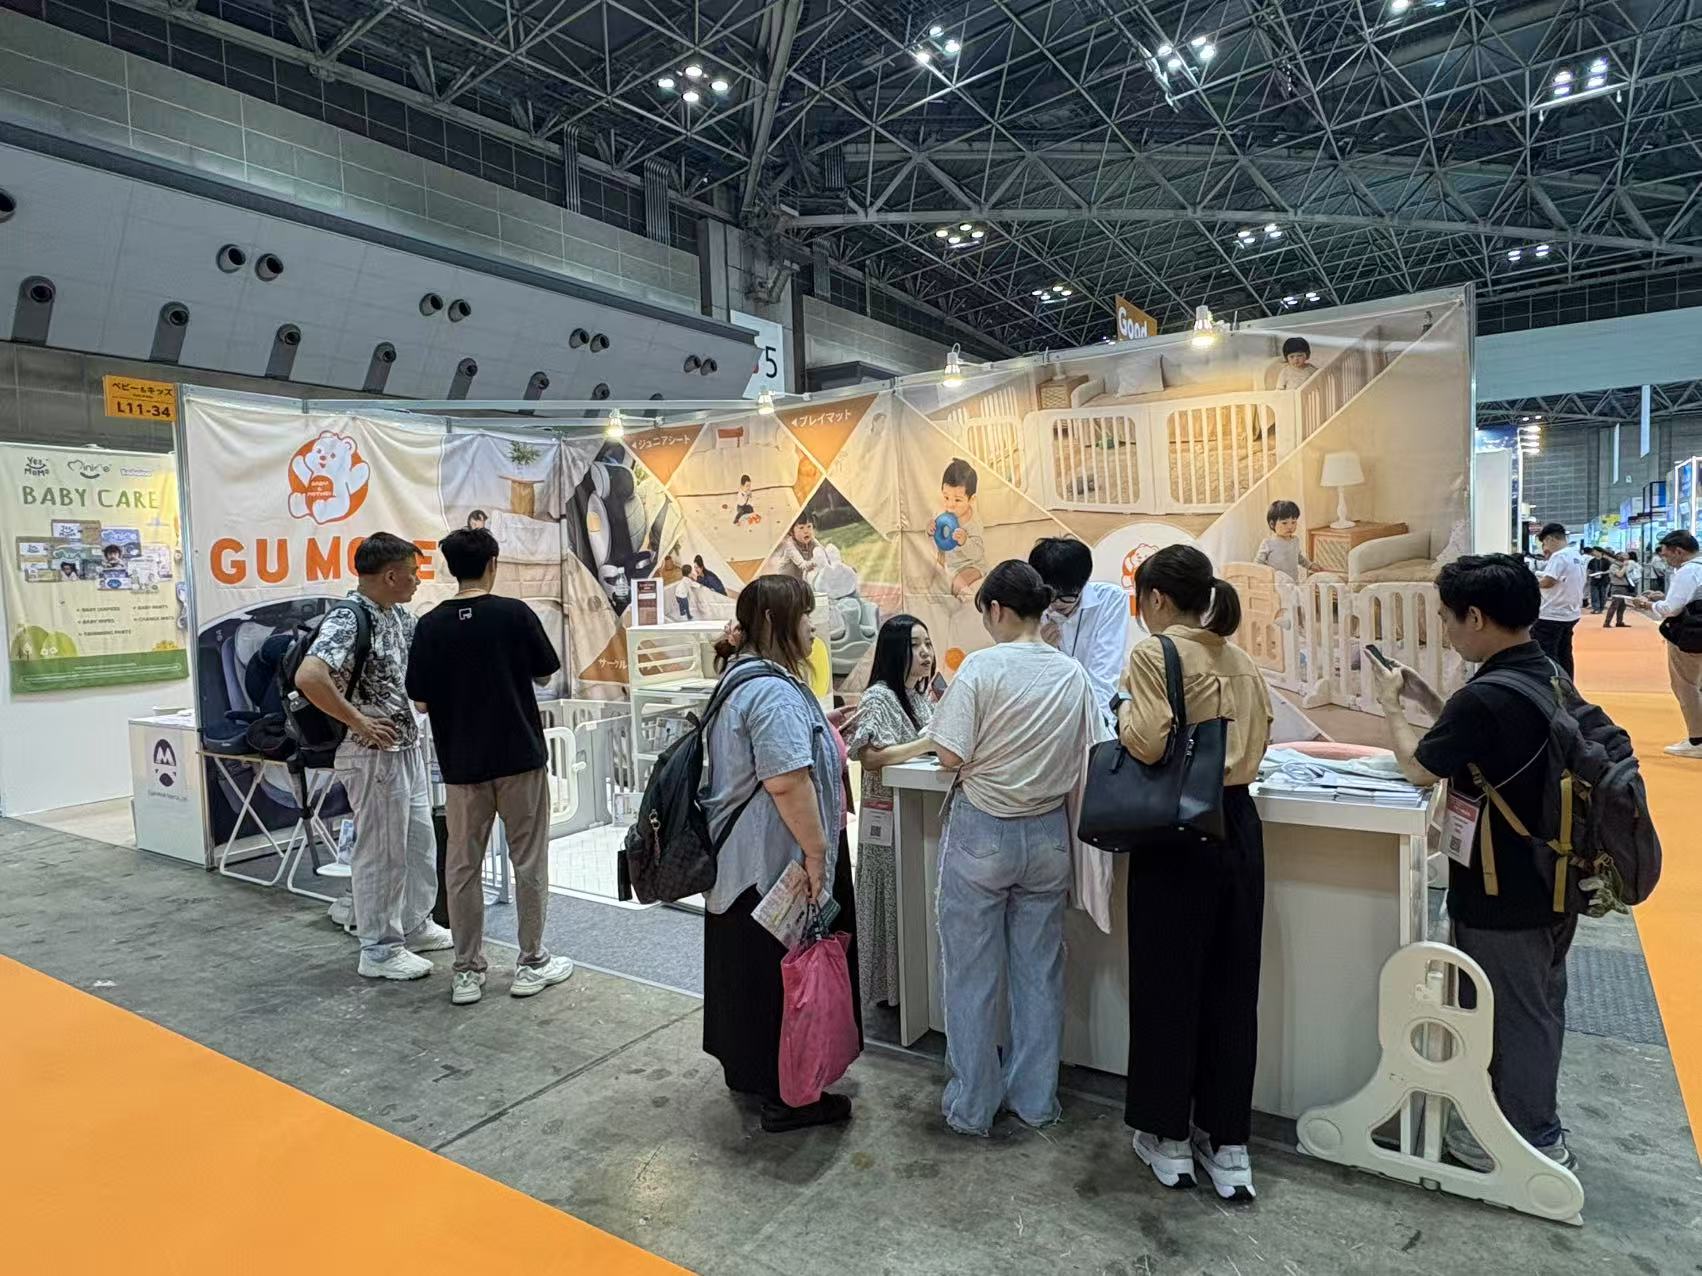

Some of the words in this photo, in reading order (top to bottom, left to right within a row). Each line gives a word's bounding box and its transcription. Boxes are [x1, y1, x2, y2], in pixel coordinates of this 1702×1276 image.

[765, 345, 778, 379] 5
[117, 400, 171, 418] L11-34
[22, 485, 87, 507] BABY
[97, 489, 159, 509] CARE
